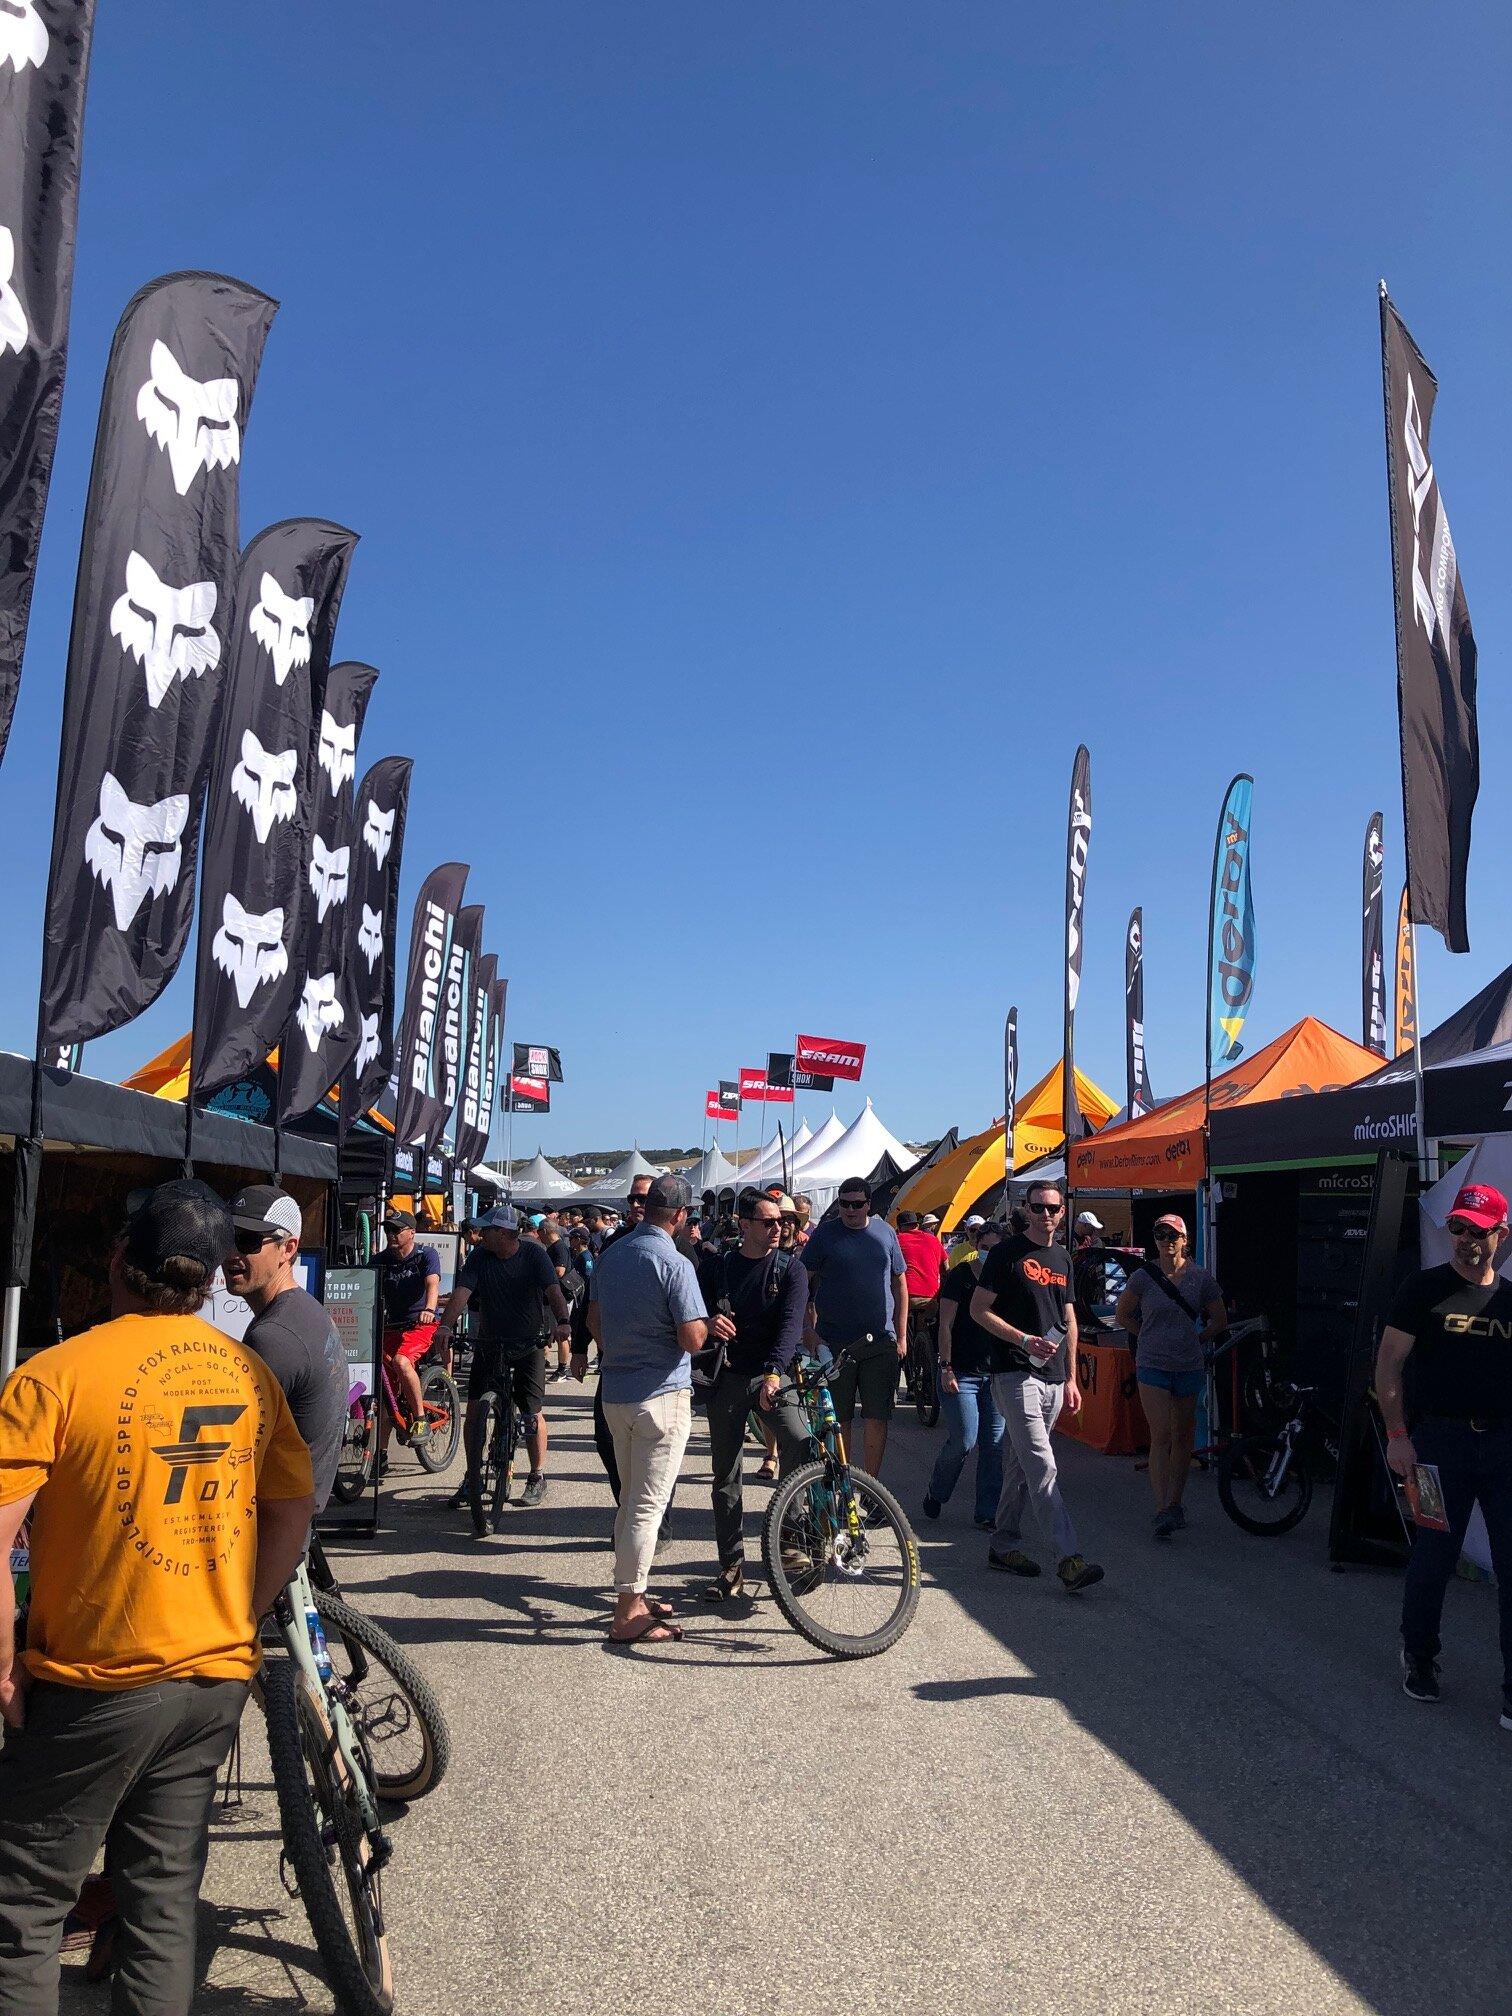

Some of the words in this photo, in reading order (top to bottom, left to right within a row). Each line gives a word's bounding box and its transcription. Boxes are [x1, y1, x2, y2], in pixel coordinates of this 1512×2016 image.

[412, 900, 445, 1096] Bianchi
[800, 1049, 860, 1068] SRAM
[1353, 1112, 1417, 1141] microSHIF
[1037, 1267, 1067, 1287] Seal
[212, 1288, 252, 1321] TOD
[326, 1292, 352, 1300] YOU?
[332, 1316, 359, 1324] ONTEST
[1443, 1313, 1512, 1340] GCN
[170, 1341, 228, 1358] RACING
[138, 1349, 168, 1376] FOX
[206, 1361, 219, 1370] SO
[222, 1366, 240, 1383] CAL
[233, 1356, 250, 1374] CO
[162, 1389, 196, 1397] MODERN
[198, 1388, 240, 1396] RACEWEAR
[191, 1378, 212, 1386] POST
[117, 1387, 138, 1454] SPEED
[116, 1466, 131, 1491] OF
[117, 1500, 191, 1577] DISCIPLES
[174, 1524, 225, 1536] REGISTERED
